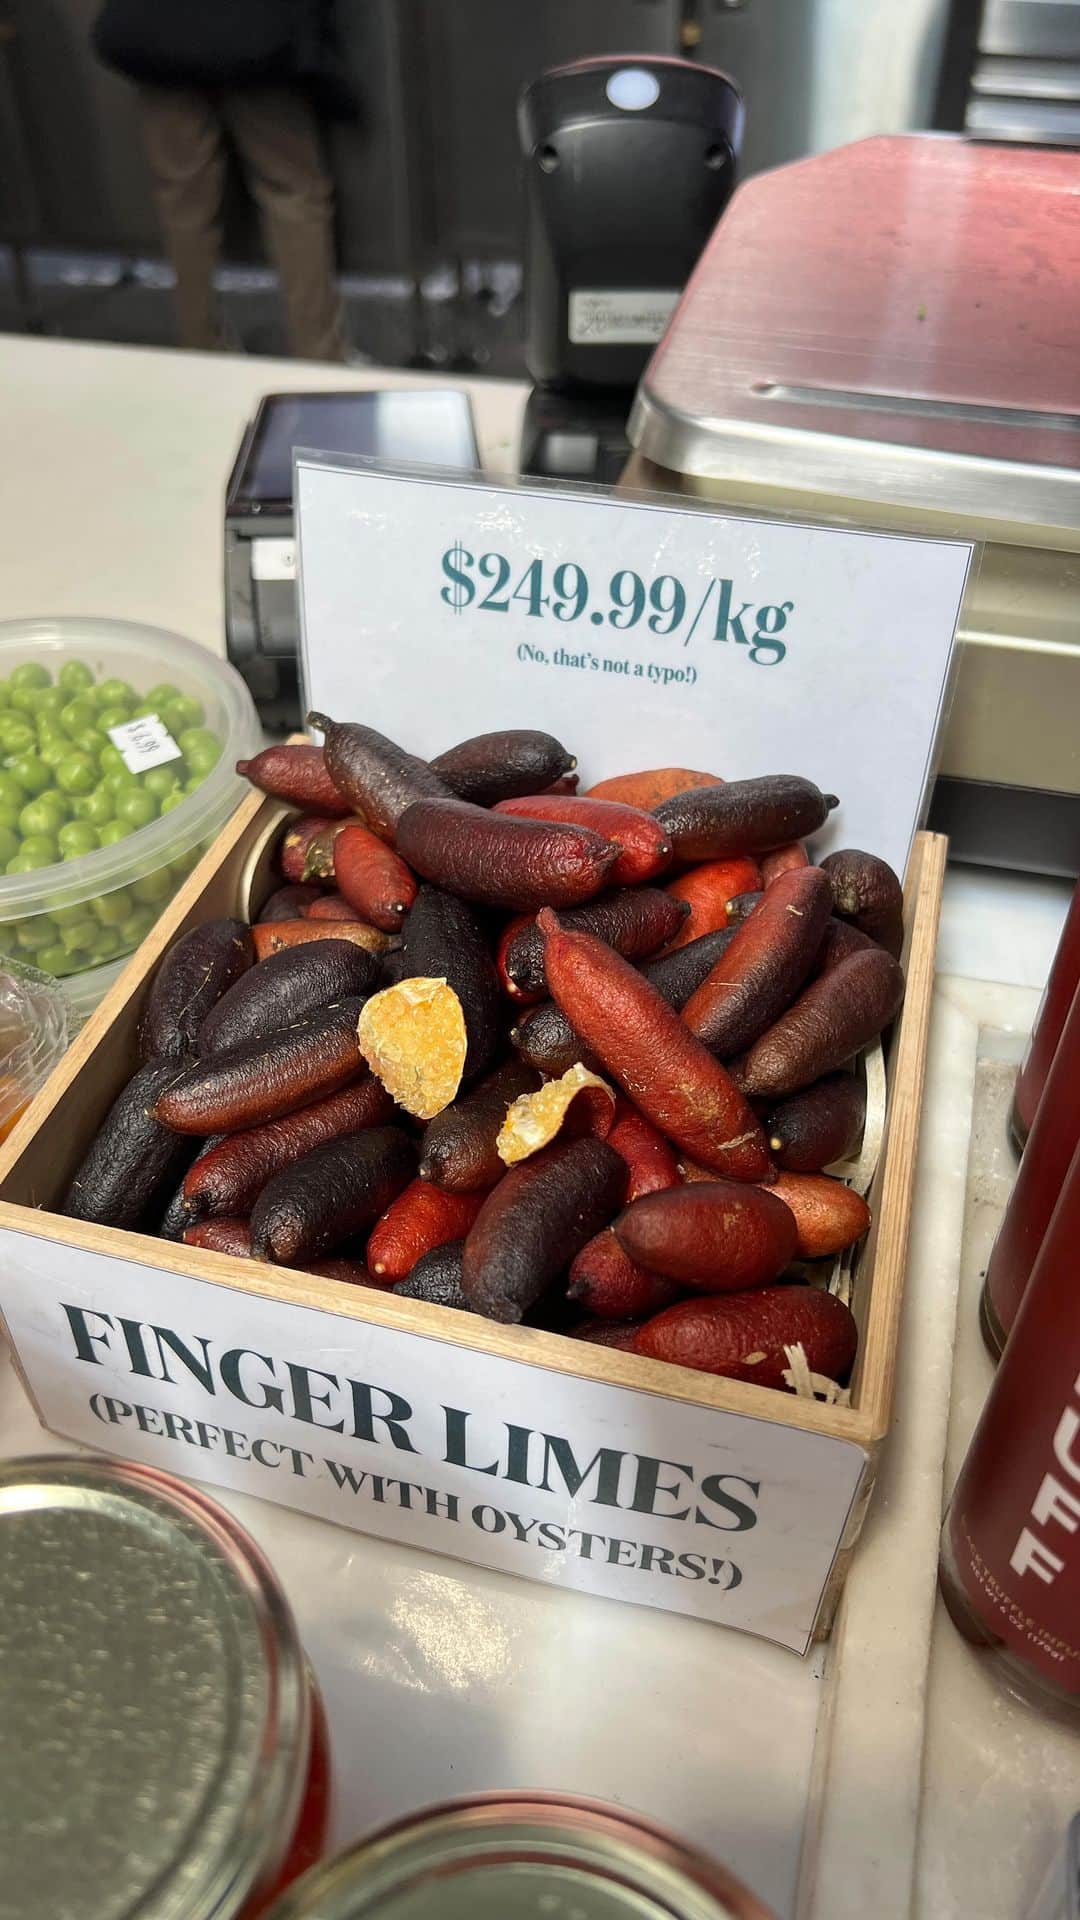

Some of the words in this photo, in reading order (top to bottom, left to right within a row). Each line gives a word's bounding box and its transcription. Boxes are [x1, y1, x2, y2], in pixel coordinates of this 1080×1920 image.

[440, 540, 794, 666] $249.99/kg
[517, 643, 550, 665] (No,
[553, 646, 600, 672] that's
[602, 657, 630, 676] not
[633, 663, 644, 677] a
[646, 663, 698, 685] typo!)
[58, 1301, 423, 1455] FINGER
[440, 1404, 761, 1532] LIMES
[88, 1392, 315, 1478] (PERFECT
[322, 1458, 464, 1522] WITH
[471, 1503, 743, 1591] OYSTERS!)
